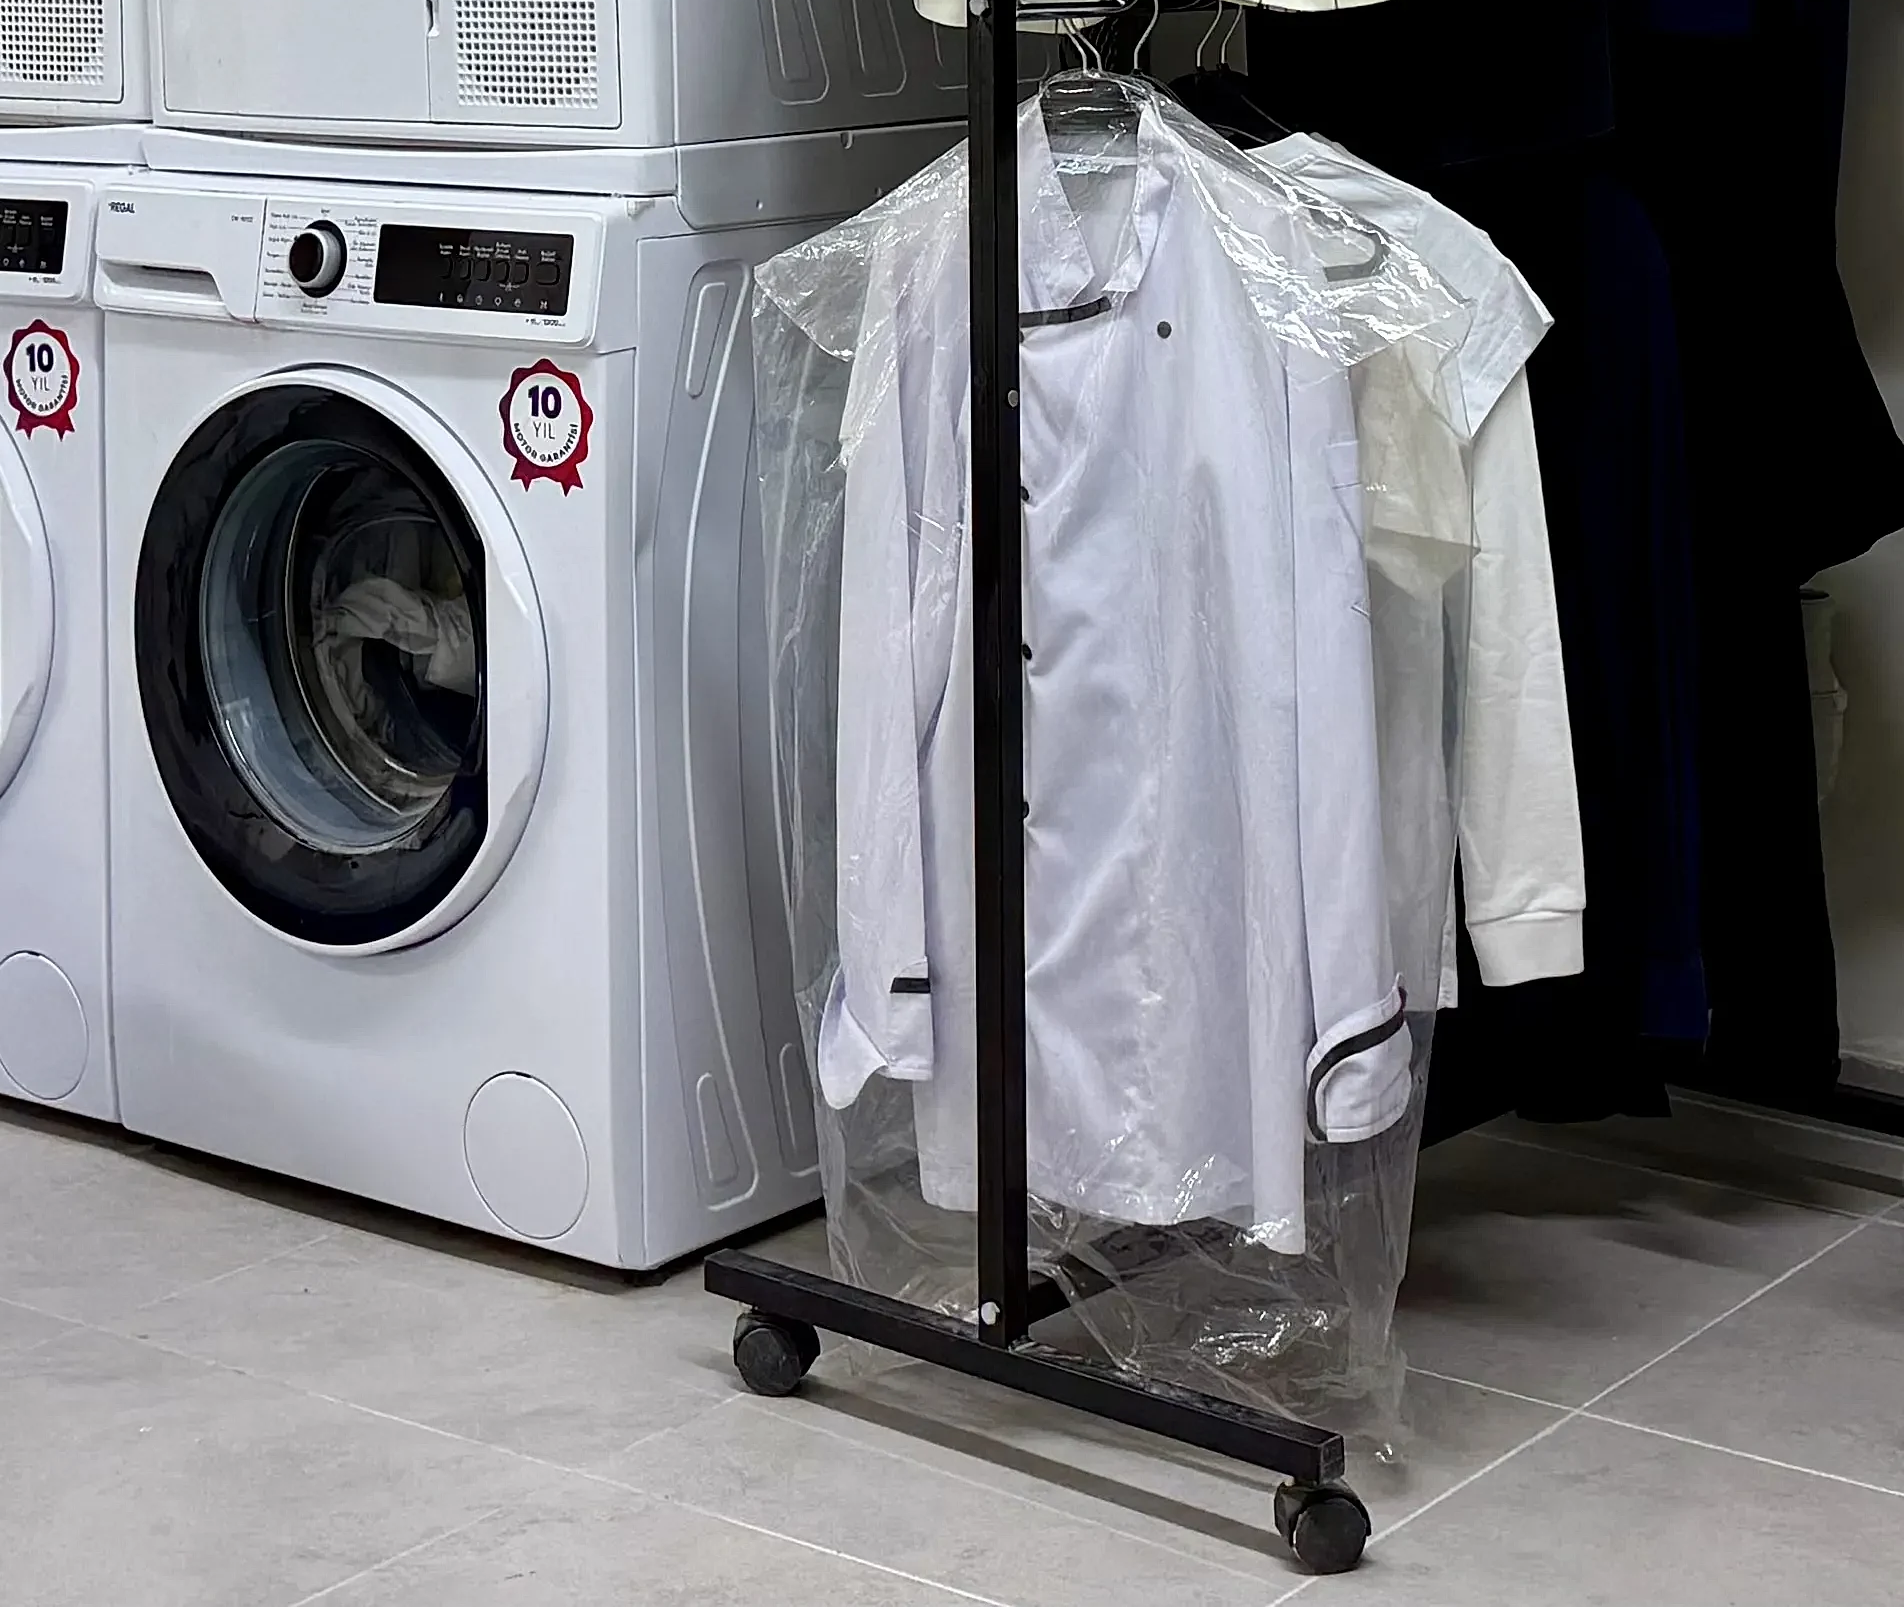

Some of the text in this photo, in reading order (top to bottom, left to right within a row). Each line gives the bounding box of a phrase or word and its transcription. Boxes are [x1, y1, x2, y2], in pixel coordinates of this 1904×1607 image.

[108, 201, 136, 215] REGAL
[25, 343, 54, 373] 10
[31, 376, 50, 392] YIL
[527, 384, 563, 419] 10
[513, 422, 538, 459] MOTOR
[532, 421, 556, 440] YIL
